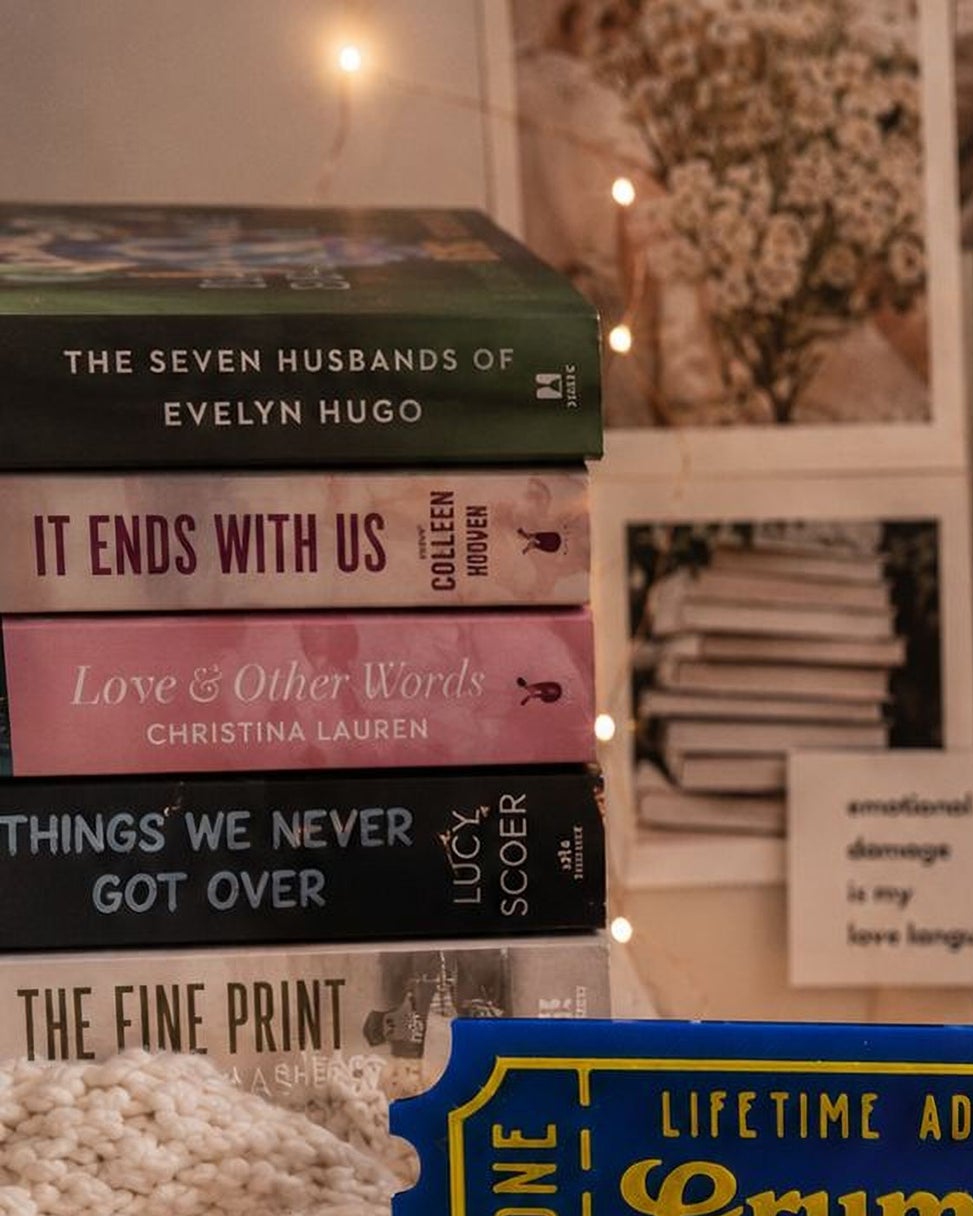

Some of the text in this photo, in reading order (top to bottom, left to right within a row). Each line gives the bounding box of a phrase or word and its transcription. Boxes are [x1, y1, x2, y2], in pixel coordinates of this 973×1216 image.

[64, 348, 514, 374] THE SEVEN HUSBANDS OF
[163, 399, 423, 428] EVELYN HUGO
[33, 514, 70, 577] IT
[90, 514, 198, 577] ENDS
[213, 513, 318, 575] WITH
[336, 512, 387, 574] US
[430, 491, 456, 592] COLLEEN
[466, 505, 488, 577] HOOVEN
[70, 658, 486, 706] Love & Other Words
[146, 718, 428, 746] CHRISTINA LAUREN
[846, 792, 973, 817] emotional
[0, 807, 414, 856] THINGS WE NEVER
[499, 794, 528, 916] SCOER
[846, 837, 950, 867] damage
[452, 809, 481, 903] LUCY
[92, 871, 326, 914] GOT OVER
[847, 881, 914, 910] is my
[847, 923, 900, 946] love
[17, 986, 96, 1062] THE
[114, 983, 208, 1055] FINE
[227, 978, 346, 1054] PRINT
[662, 1090, 879, 1141] LIFETIME
